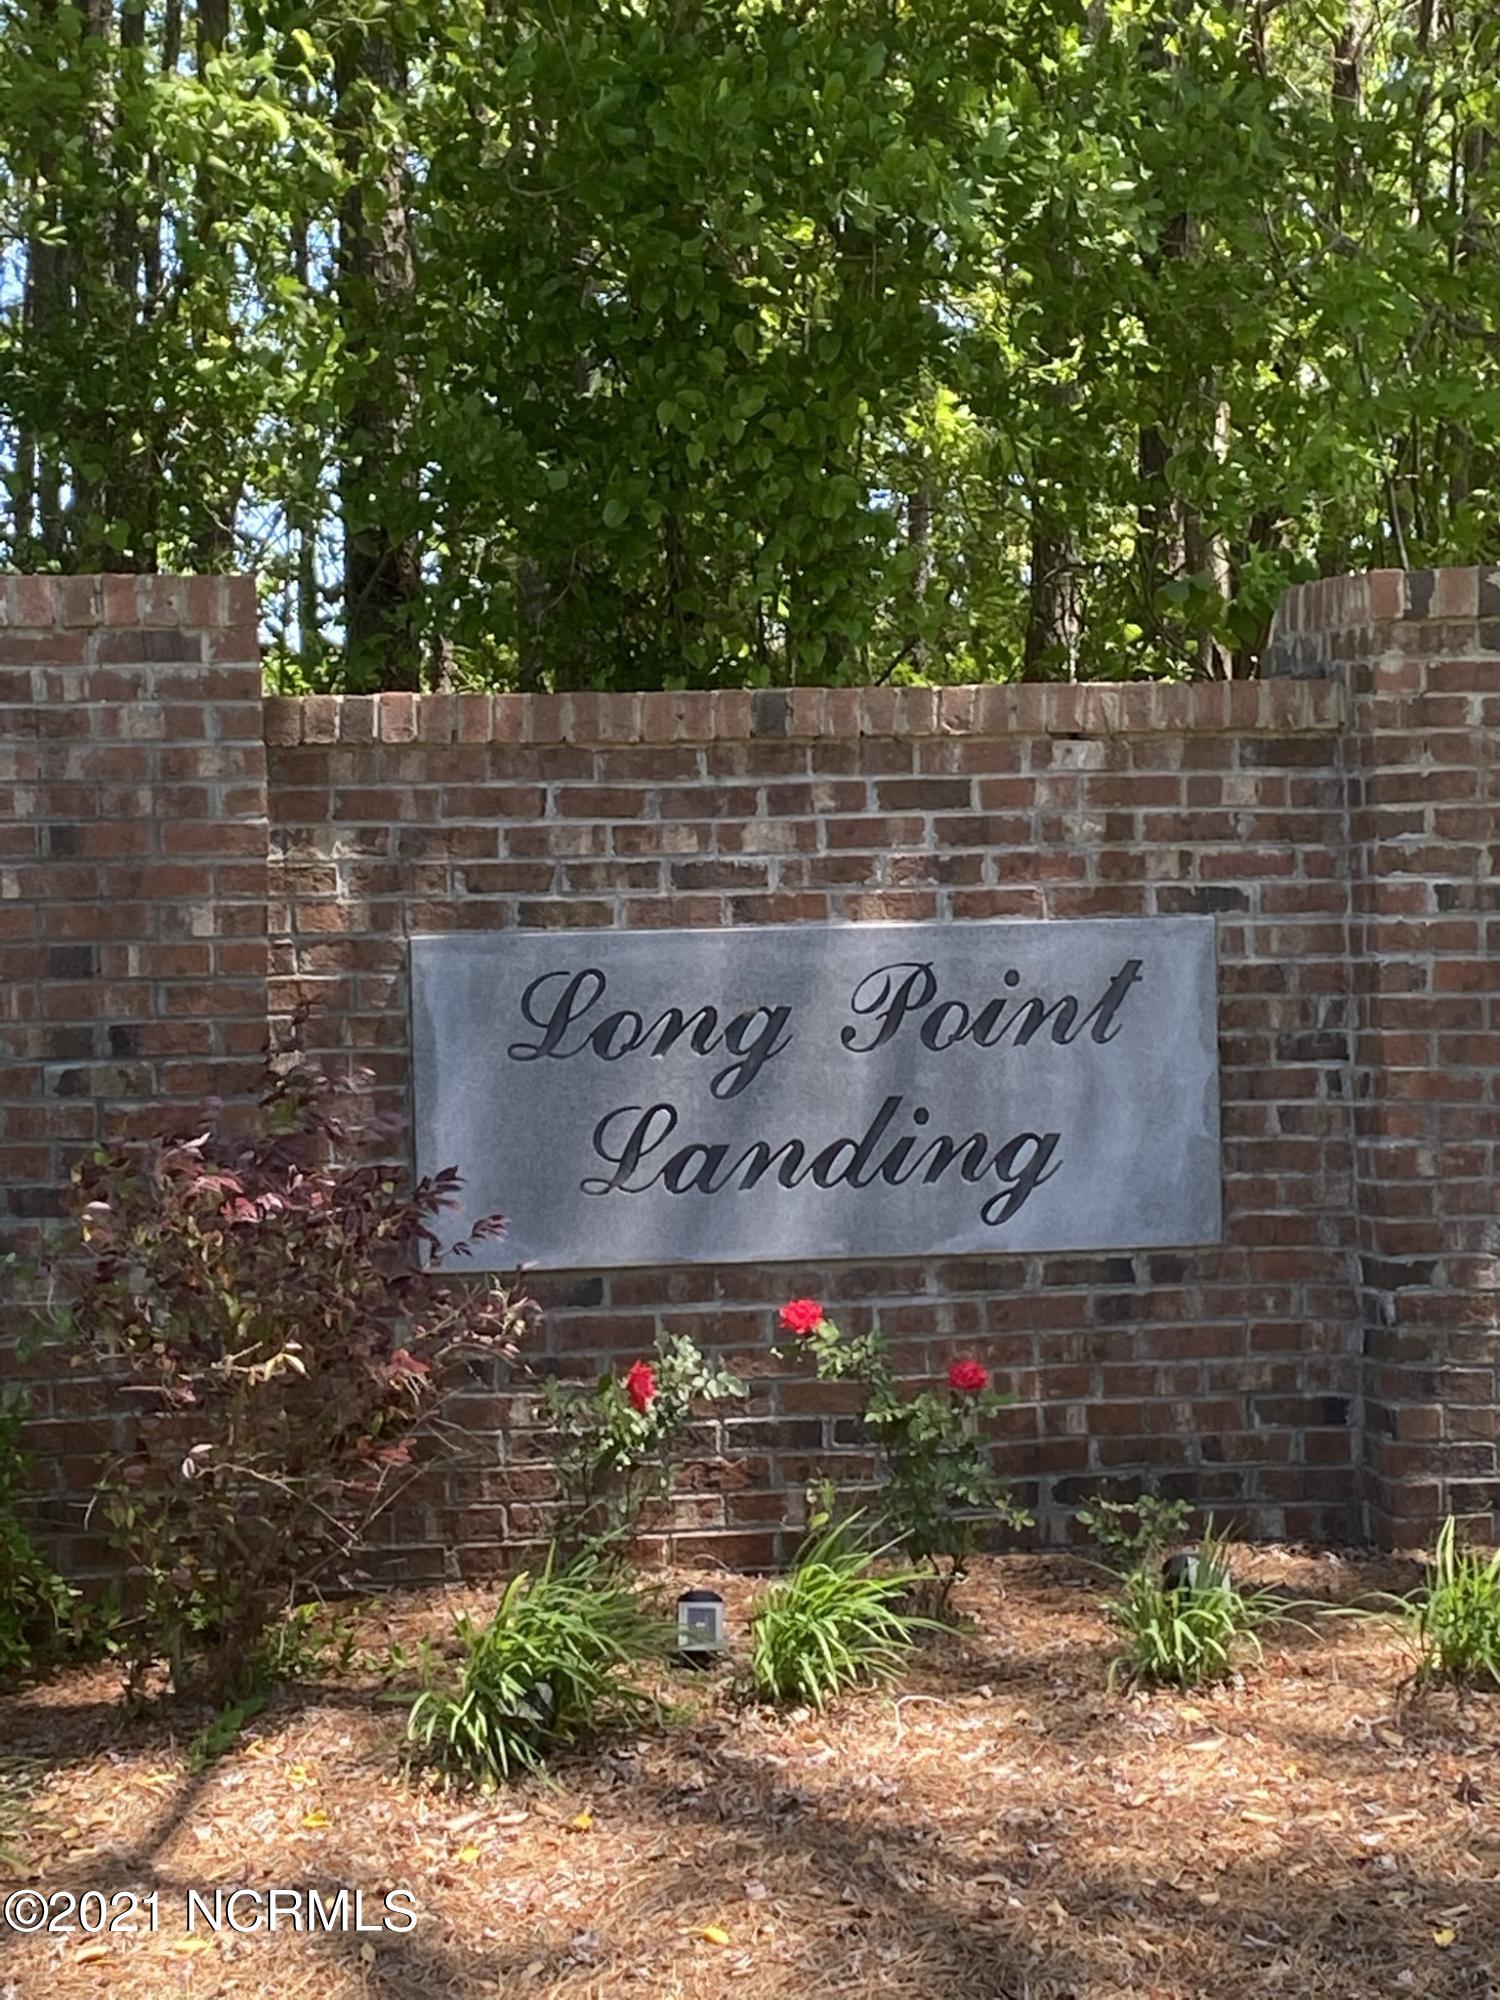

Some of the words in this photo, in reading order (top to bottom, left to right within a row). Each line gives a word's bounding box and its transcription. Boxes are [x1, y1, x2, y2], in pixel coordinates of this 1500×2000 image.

[507, 967, 794, 1100] Long
[840, 958, 1144, 1053] Point
[579, 1095, 1062, 1226] Landing
